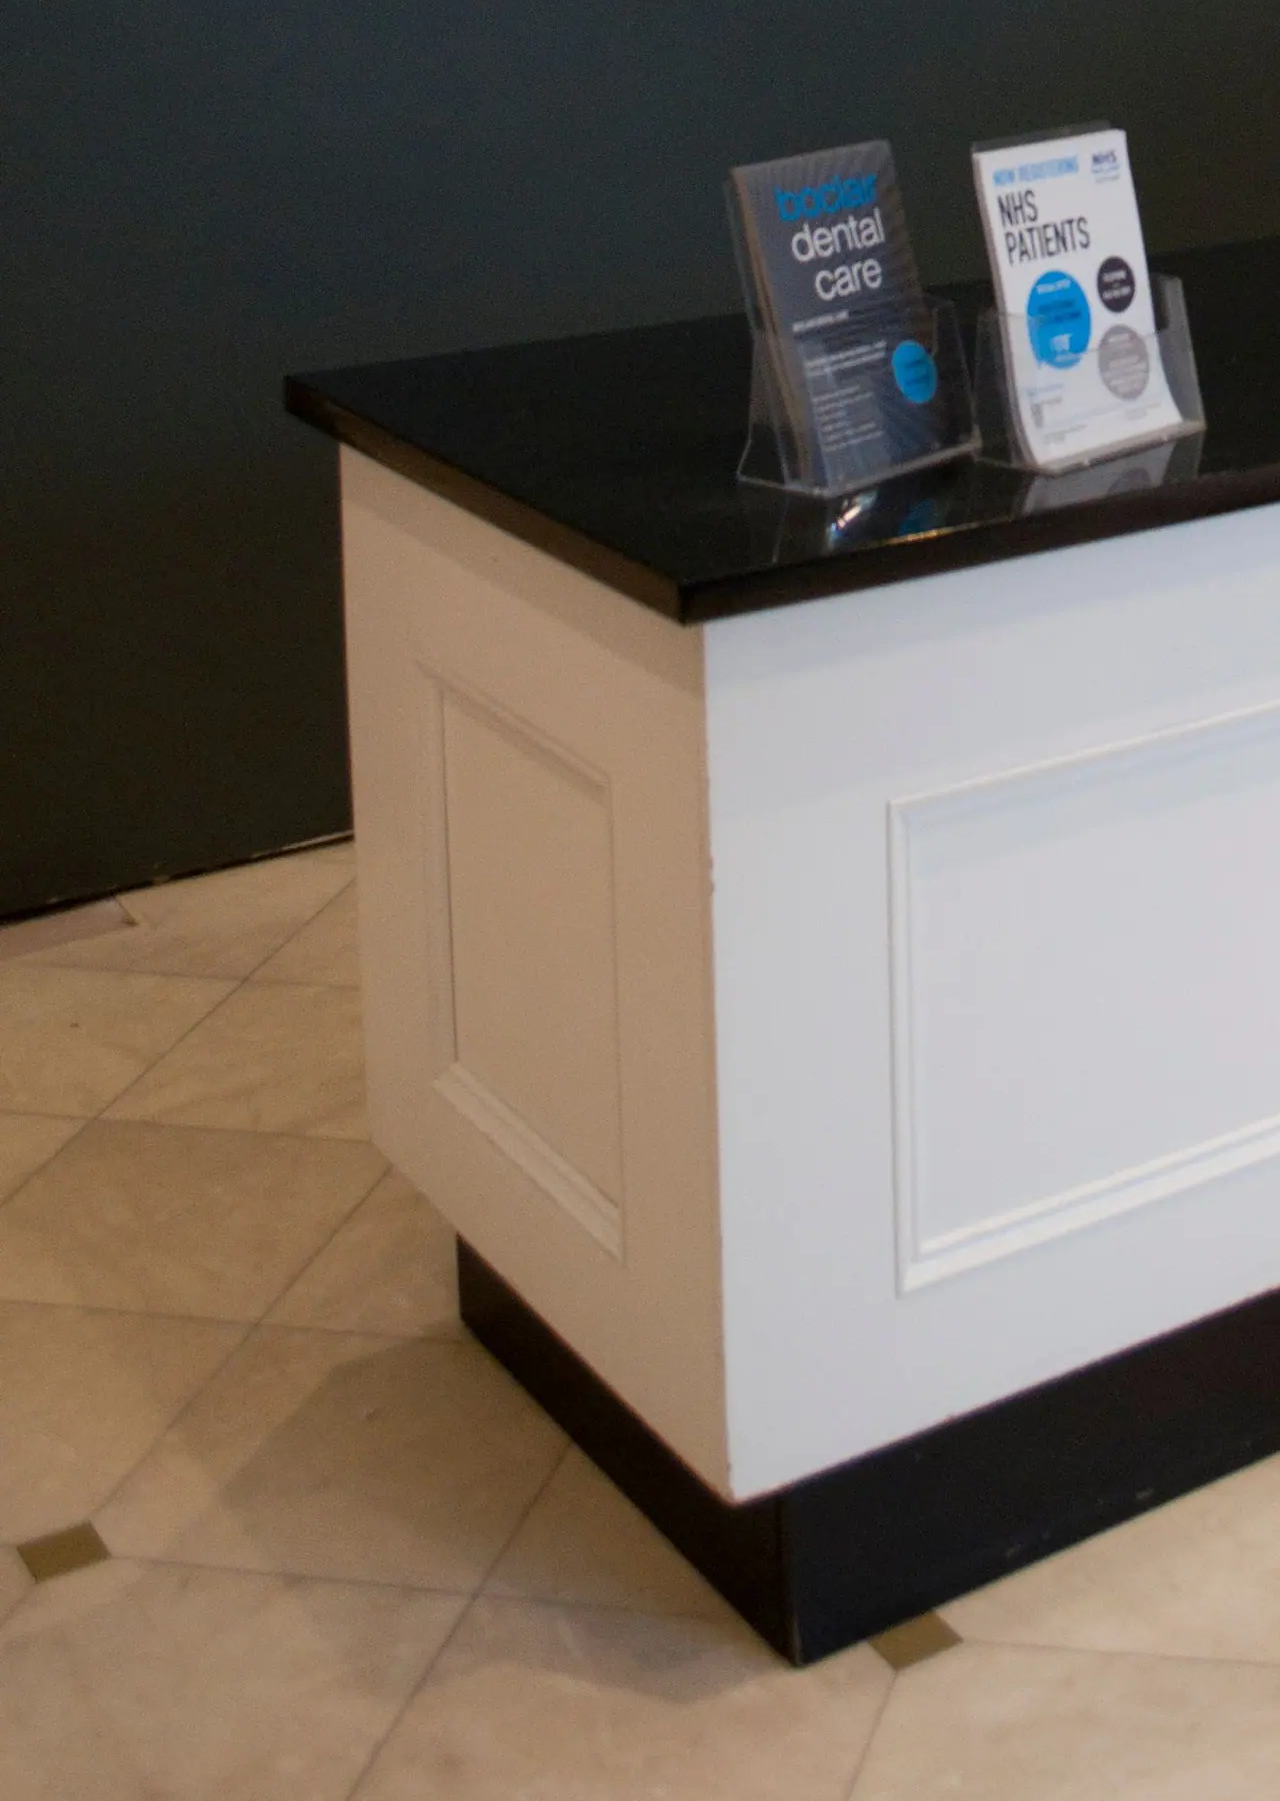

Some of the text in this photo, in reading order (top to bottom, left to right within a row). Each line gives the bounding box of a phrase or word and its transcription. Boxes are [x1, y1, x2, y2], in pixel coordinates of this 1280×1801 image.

[997, 190, 1039, 228] NHS
[791, 206, 886, 262] dental
[1004, 216, 1091, 266] PATIENTS
[815, 258, 882, 301] care
